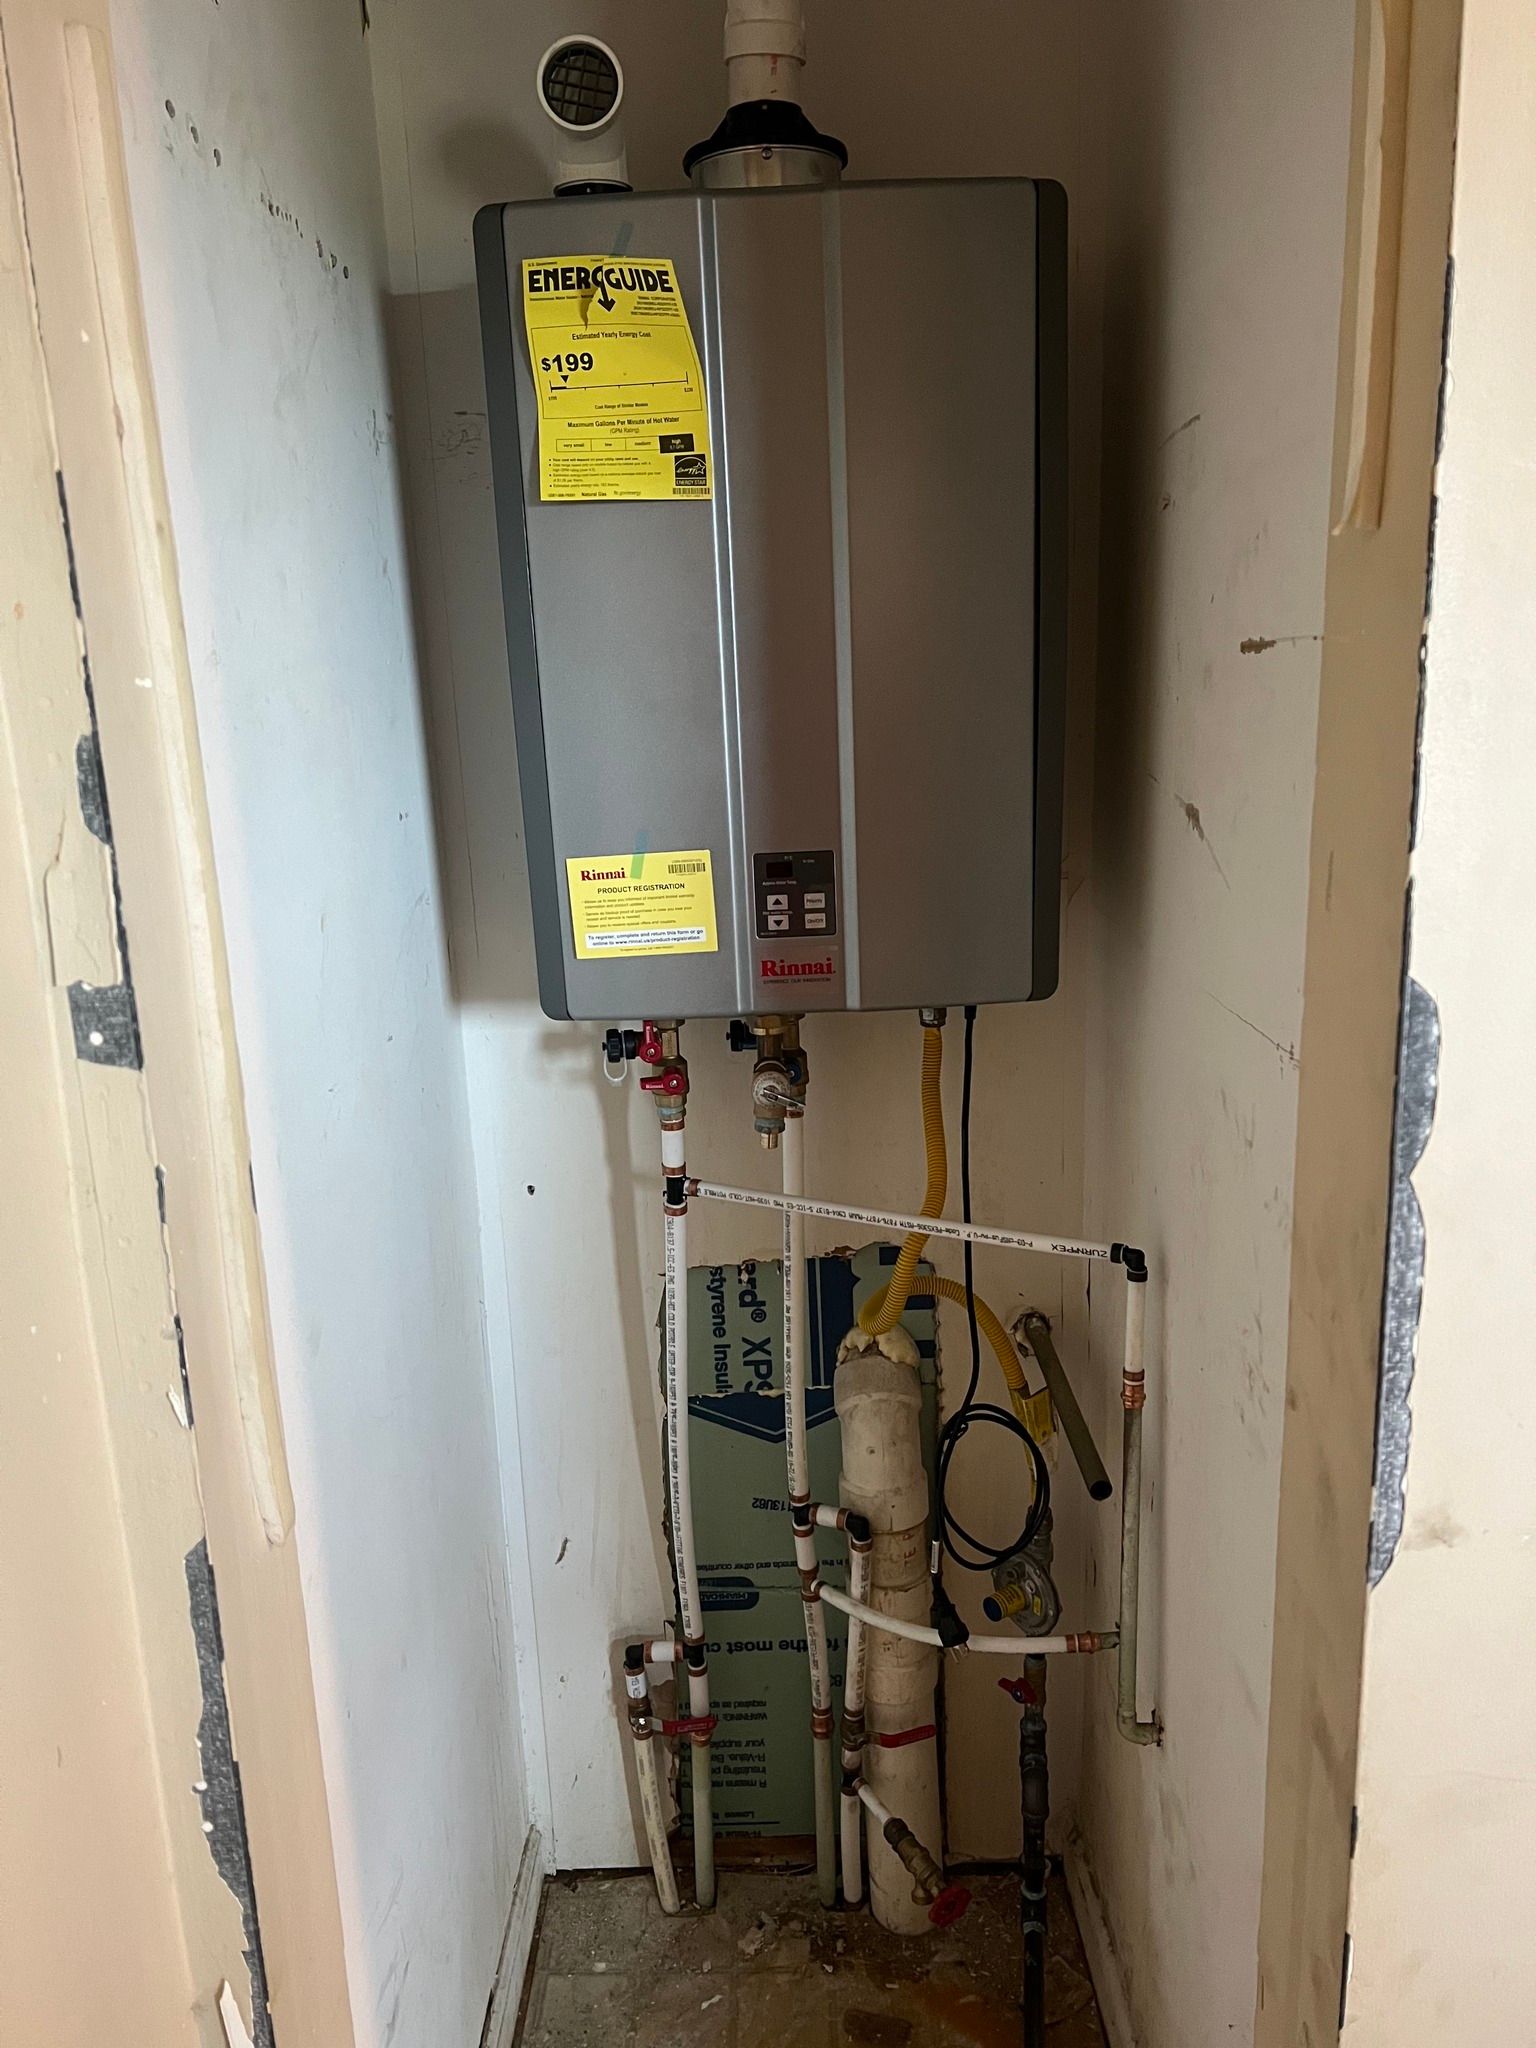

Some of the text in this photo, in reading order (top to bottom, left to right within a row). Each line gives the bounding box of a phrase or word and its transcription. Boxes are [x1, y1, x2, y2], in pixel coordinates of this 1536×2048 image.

[541, 352, 594, 373] $199
[580, 867, 626, 881] Rinnai
[597, 883, 685, 894] PRODUCT REGISTRATION
[761, 957, 833, 977] Rinnai
[726, 1641, 773, 1655] most
[779, 1640, 808, 1653] the
